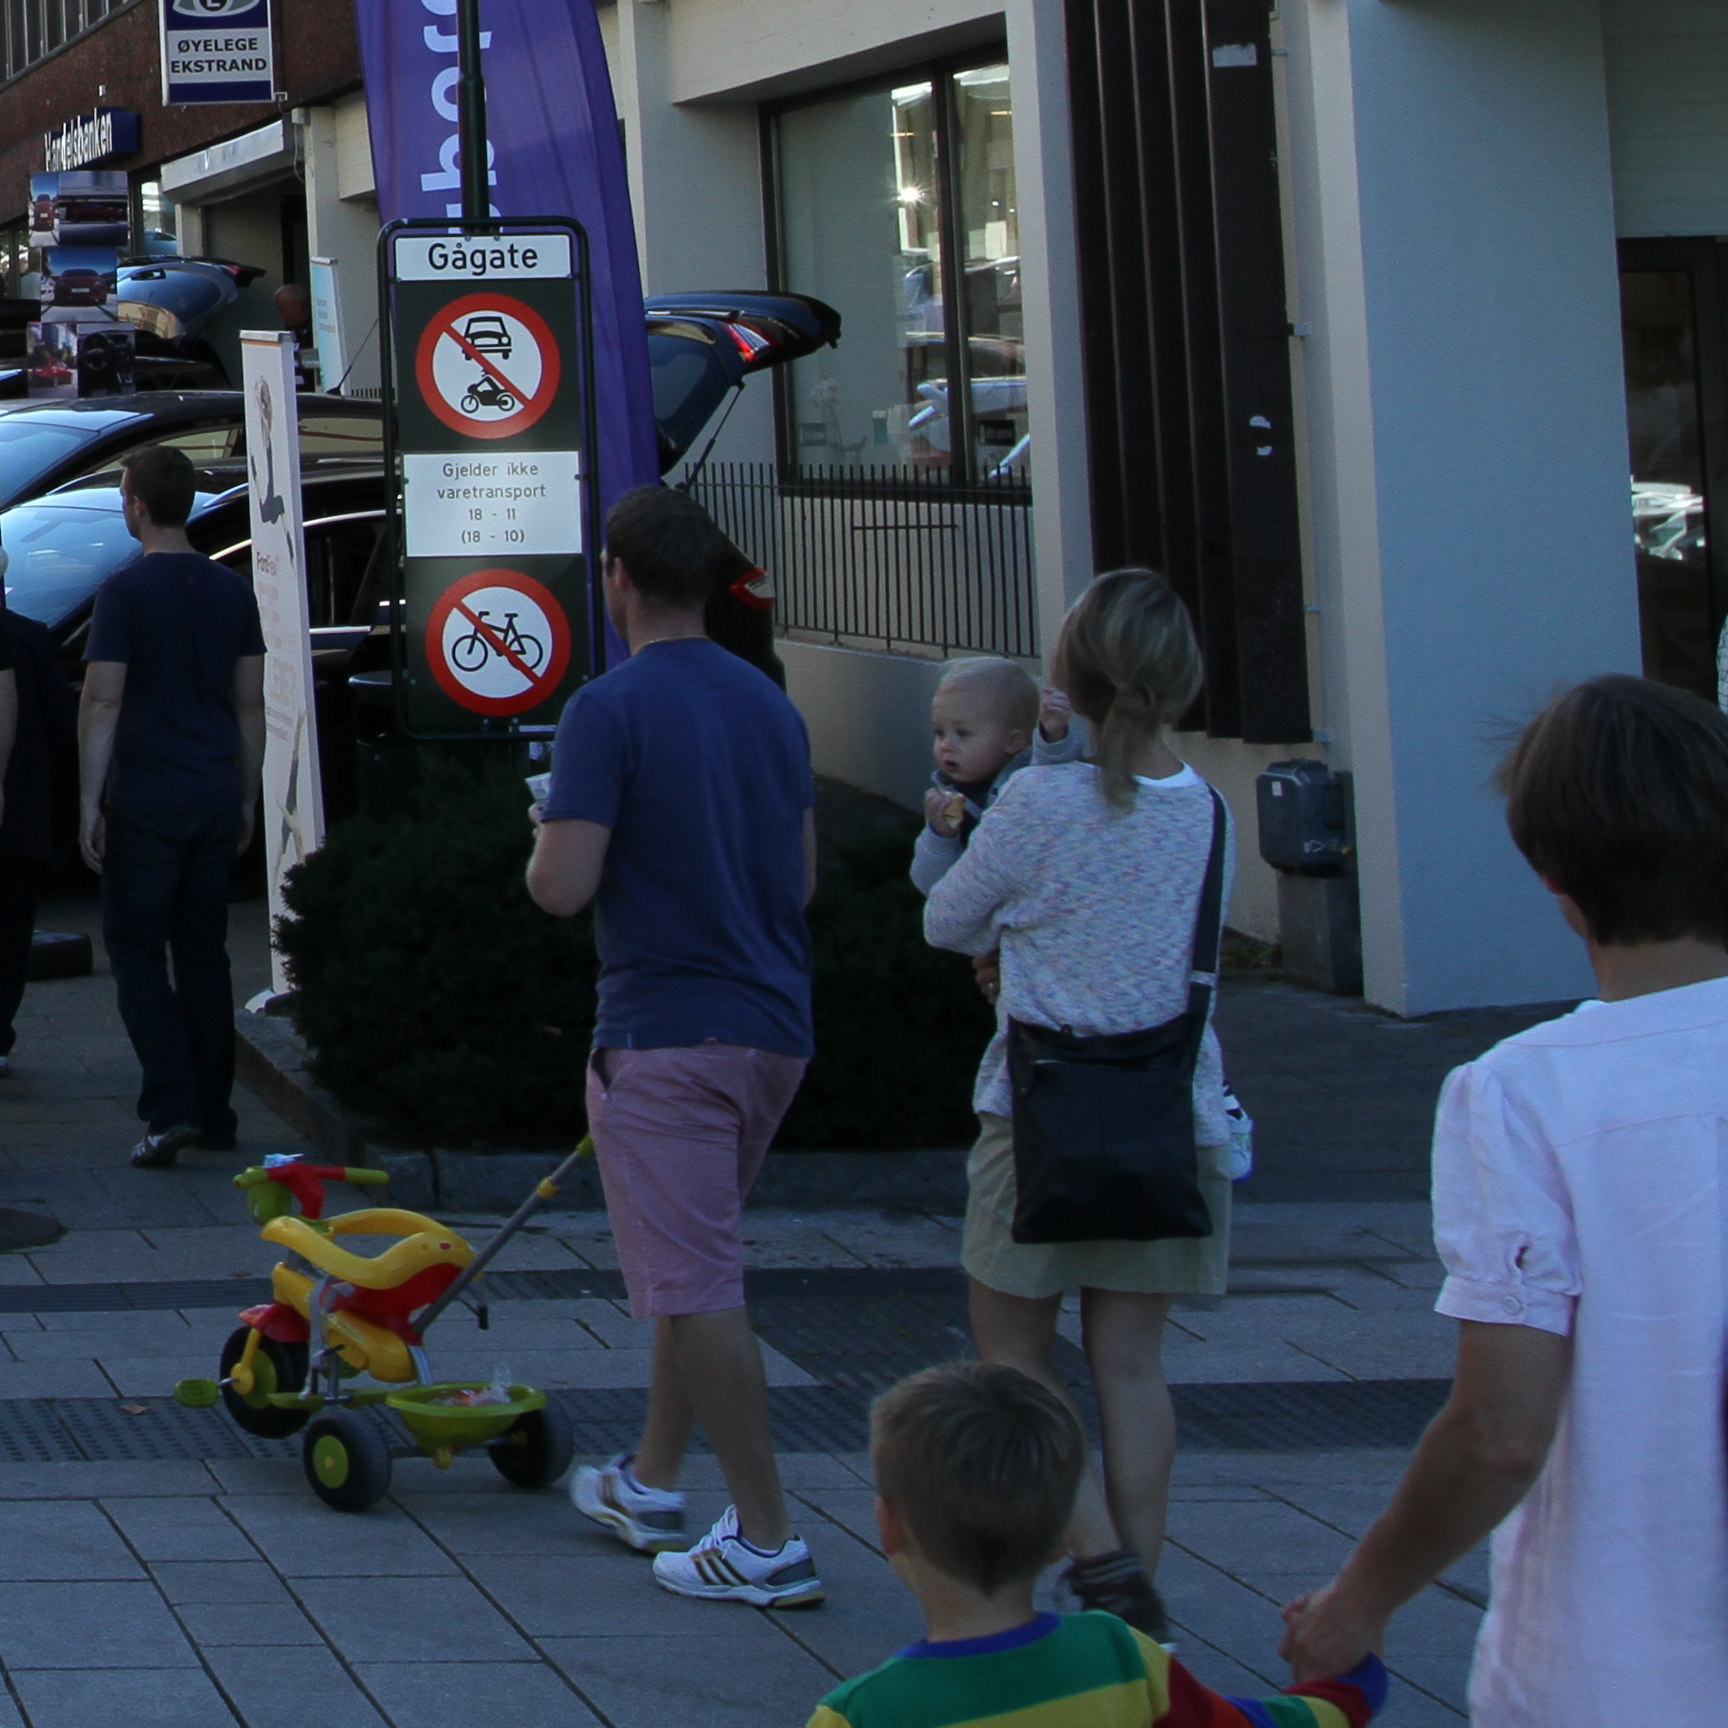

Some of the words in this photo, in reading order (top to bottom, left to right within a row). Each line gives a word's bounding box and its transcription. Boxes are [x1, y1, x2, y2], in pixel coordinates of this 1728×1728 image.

[177, 38, 258, 53] ØYELEGE
[171, 58, 266, 73] EKSTRAND
[44, 107, 113, 172] Handelsbanken
[428, 242, 538, 276] Gågate
[443, 462, 498, 480] Gjelder
[507, 462, 539, 476] ikke
[437, 484, 547, 501] varetransport
[469, 508, 483, 521] 18
[506, 508, 516, 520] 11
[461, 530, 481, 544] (18
[505, 529, 525, 543] 10)
